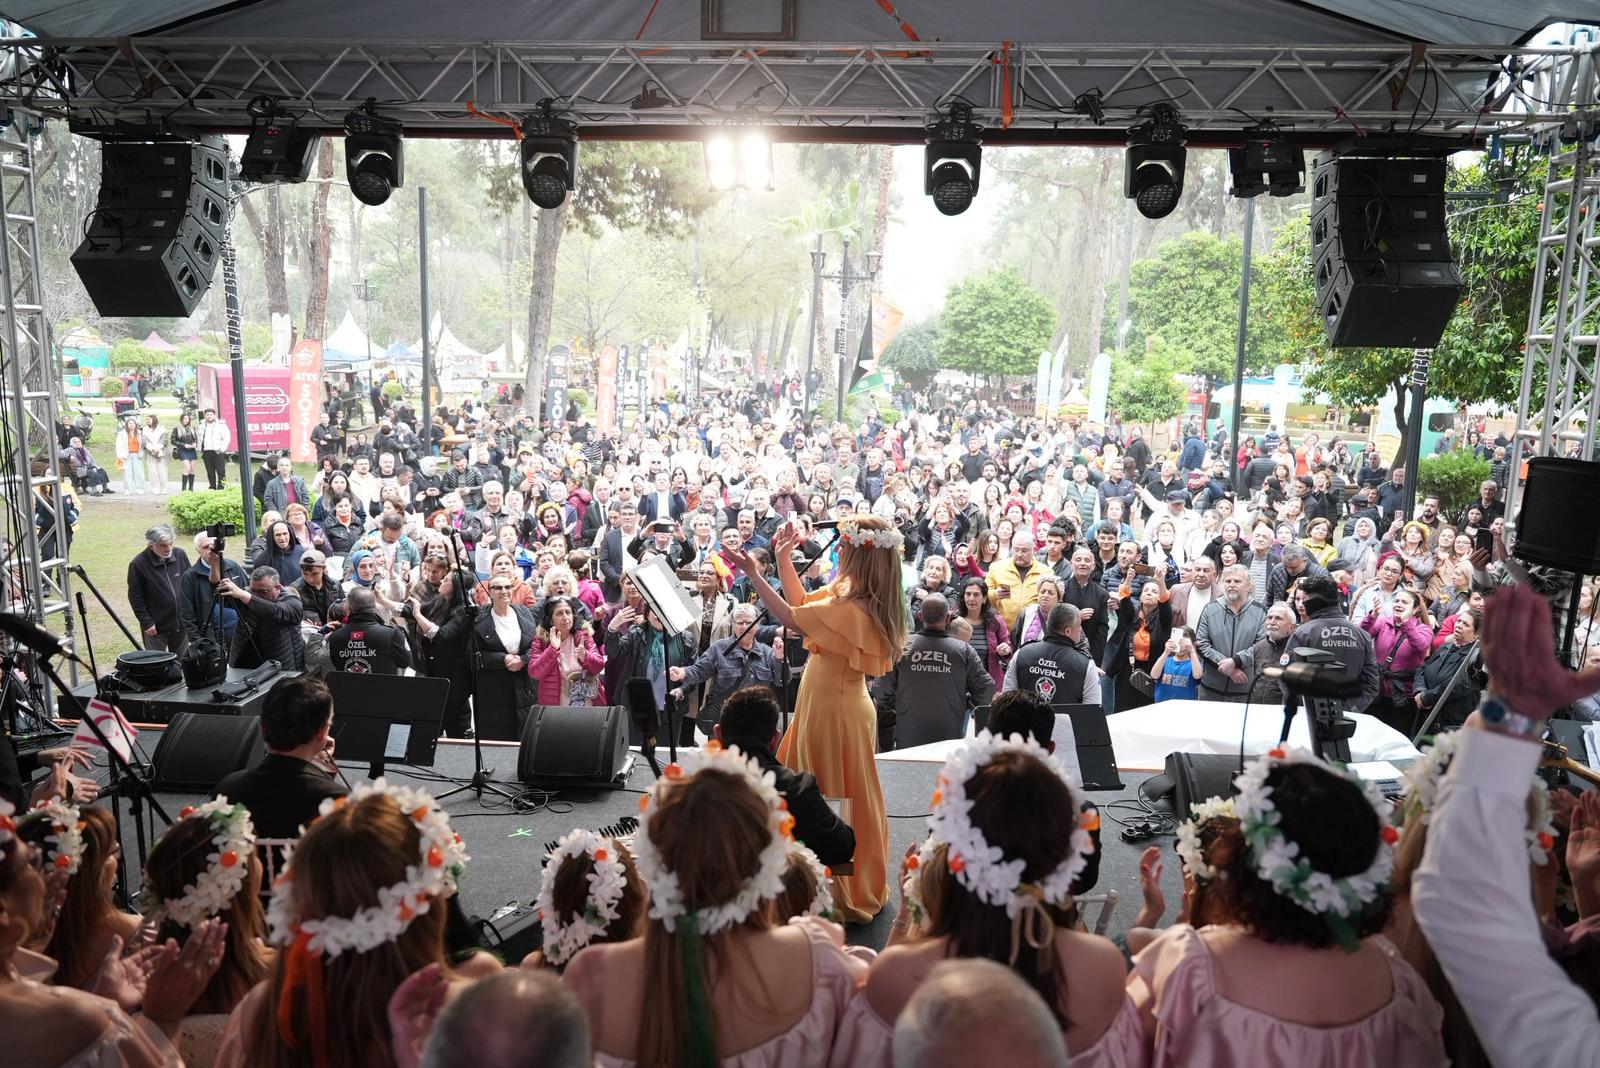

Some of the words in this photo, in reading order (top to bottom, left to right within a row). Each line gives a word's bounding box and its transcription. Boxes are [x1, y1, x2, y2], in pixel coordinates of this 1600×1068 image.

[298, 384, 313, 456] SOSIS
[261, 422, 290, 432] SOSIS
[1320, 626, 1357, 640] ÖZEL
[347, 640, 367, 649] ÖZEL
[1321, 638, 1358, 648] GÜVENLİK
[911, 649, 952, 666] ÖZEL
[1038, 656, 1058, 669] ÖZEL
[910, 663, 952, 674] GÜVENLİK
[1029, 665, 1066, 680] GÜVENLİK
